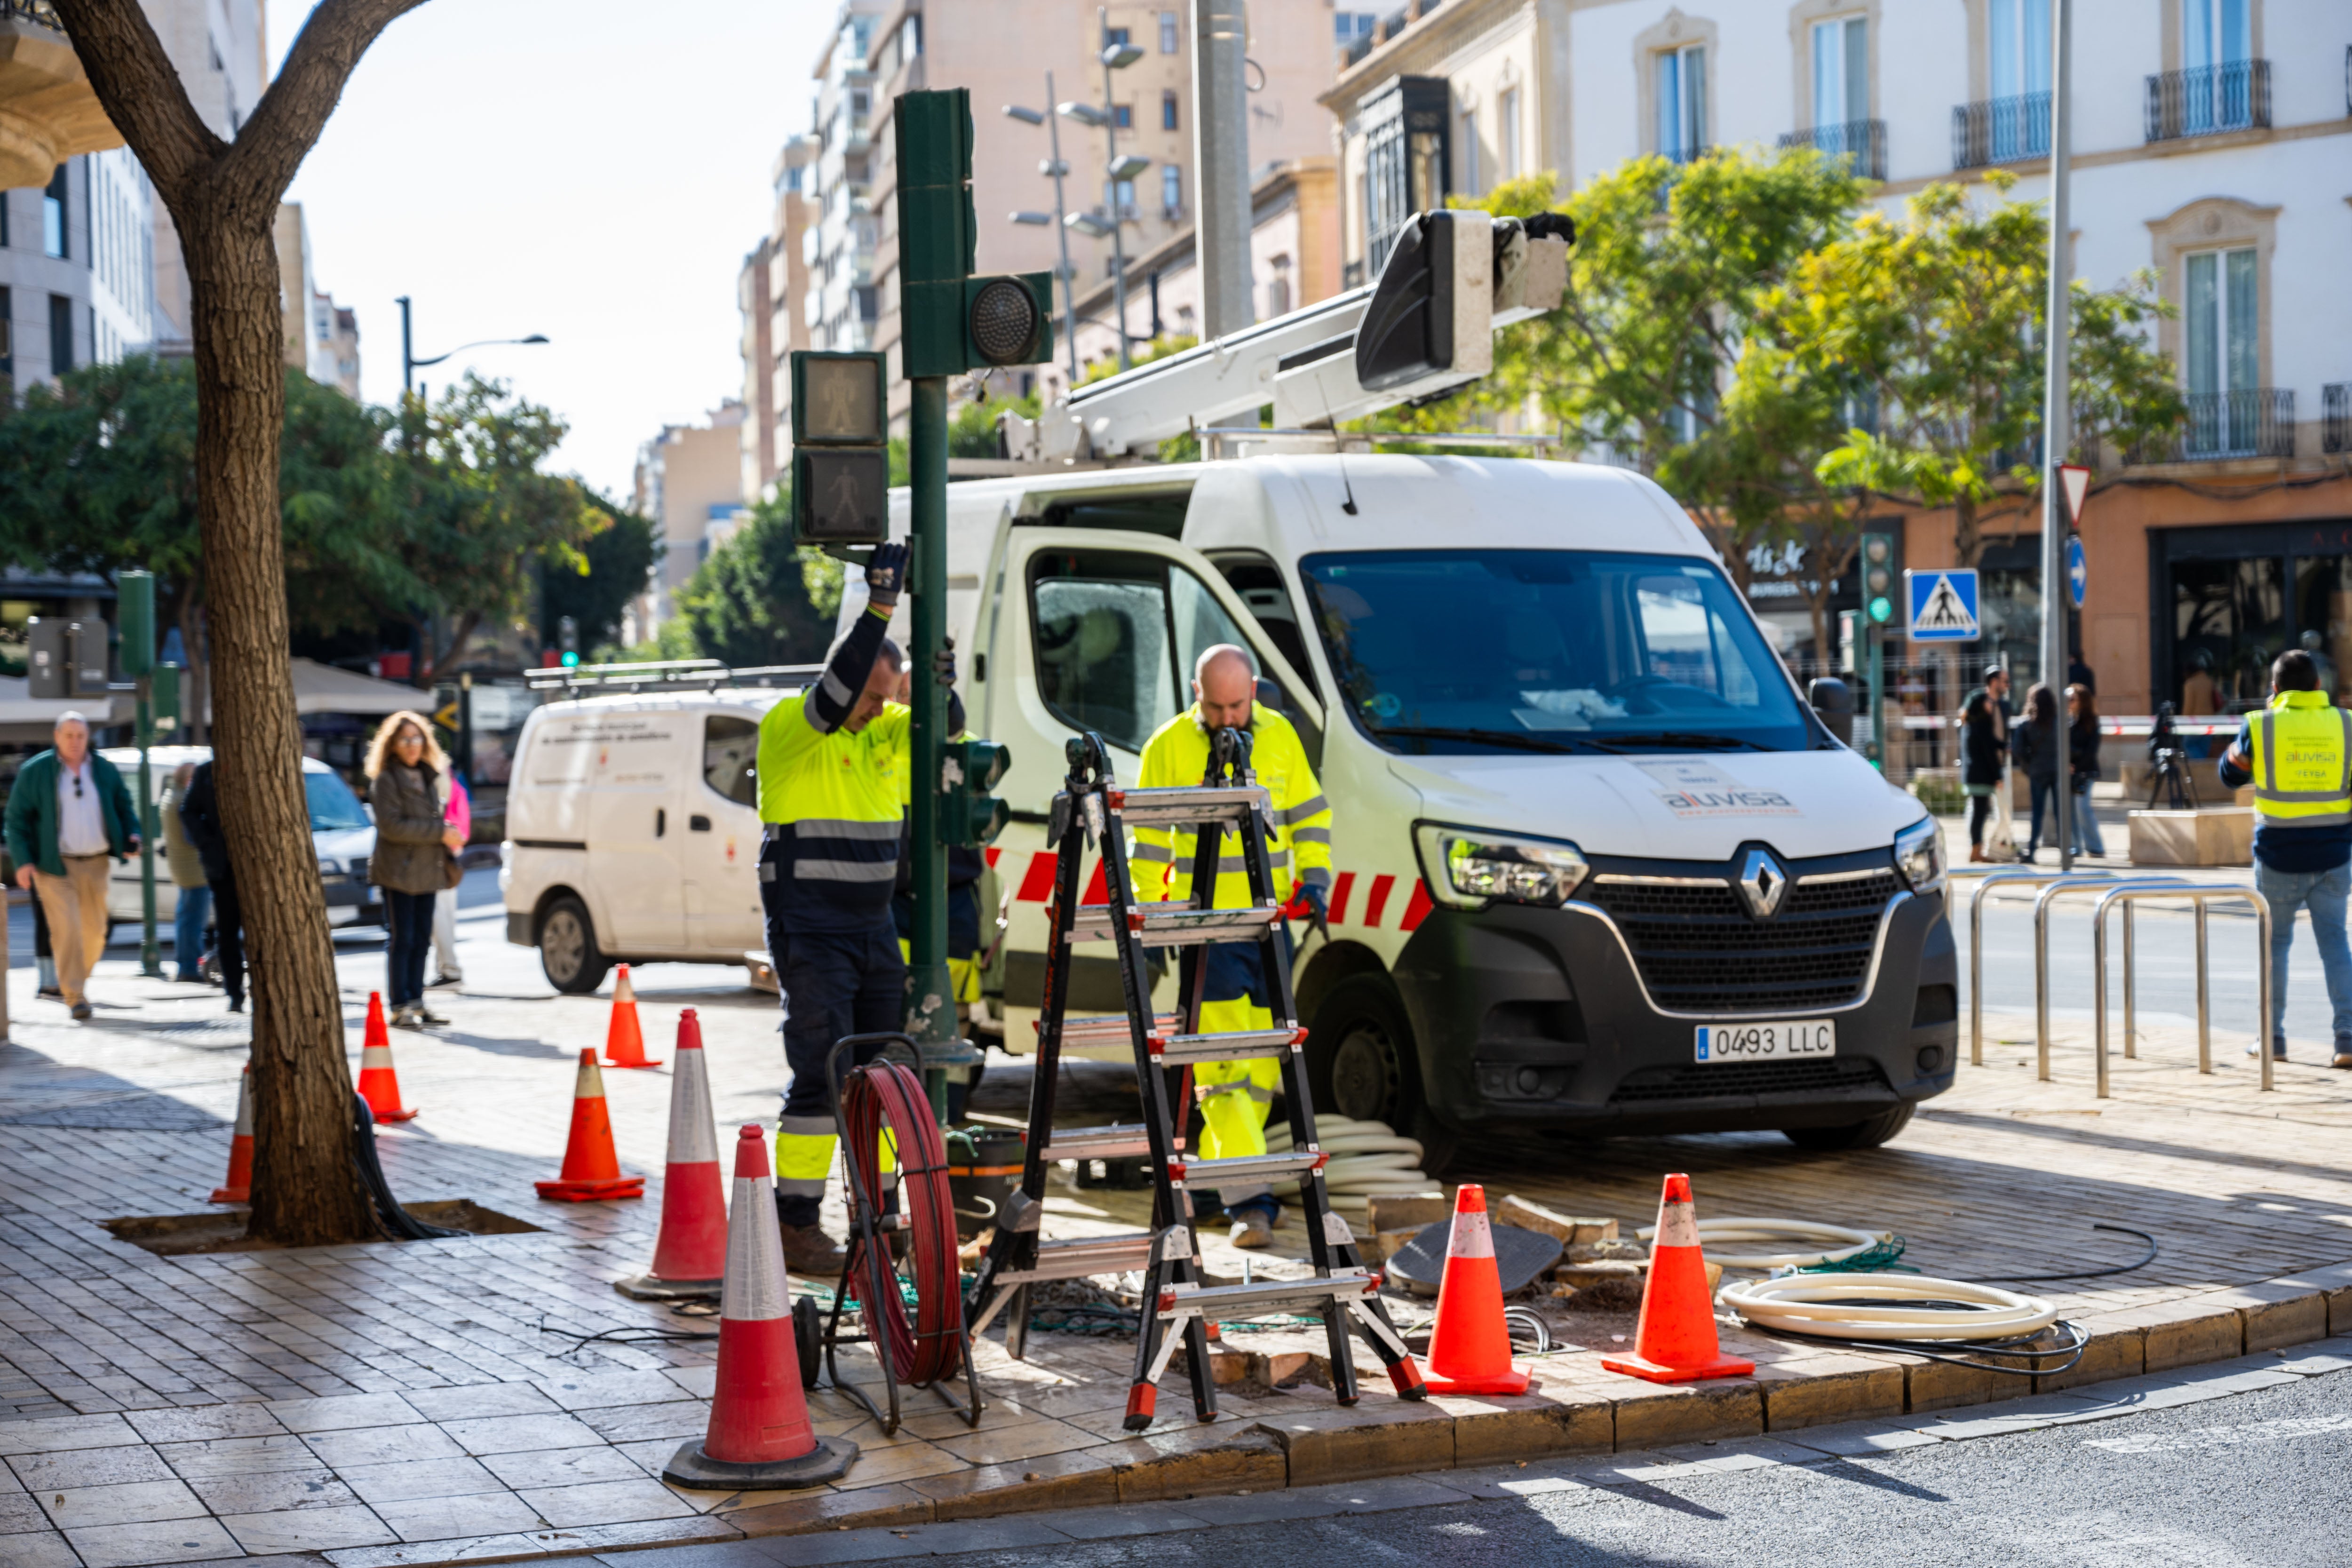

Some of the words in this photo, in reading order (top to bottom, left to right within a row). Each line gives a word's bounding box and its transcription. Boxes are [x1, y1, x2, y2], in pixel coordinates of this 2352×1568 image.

[2286, 748, 2336, 763] aluvisa
[1662, 788, 1791, 808] aluvisa
[1717, 1028, 1775, 1055] 0493
[1789, 1025, 1829, 1052] LLC
